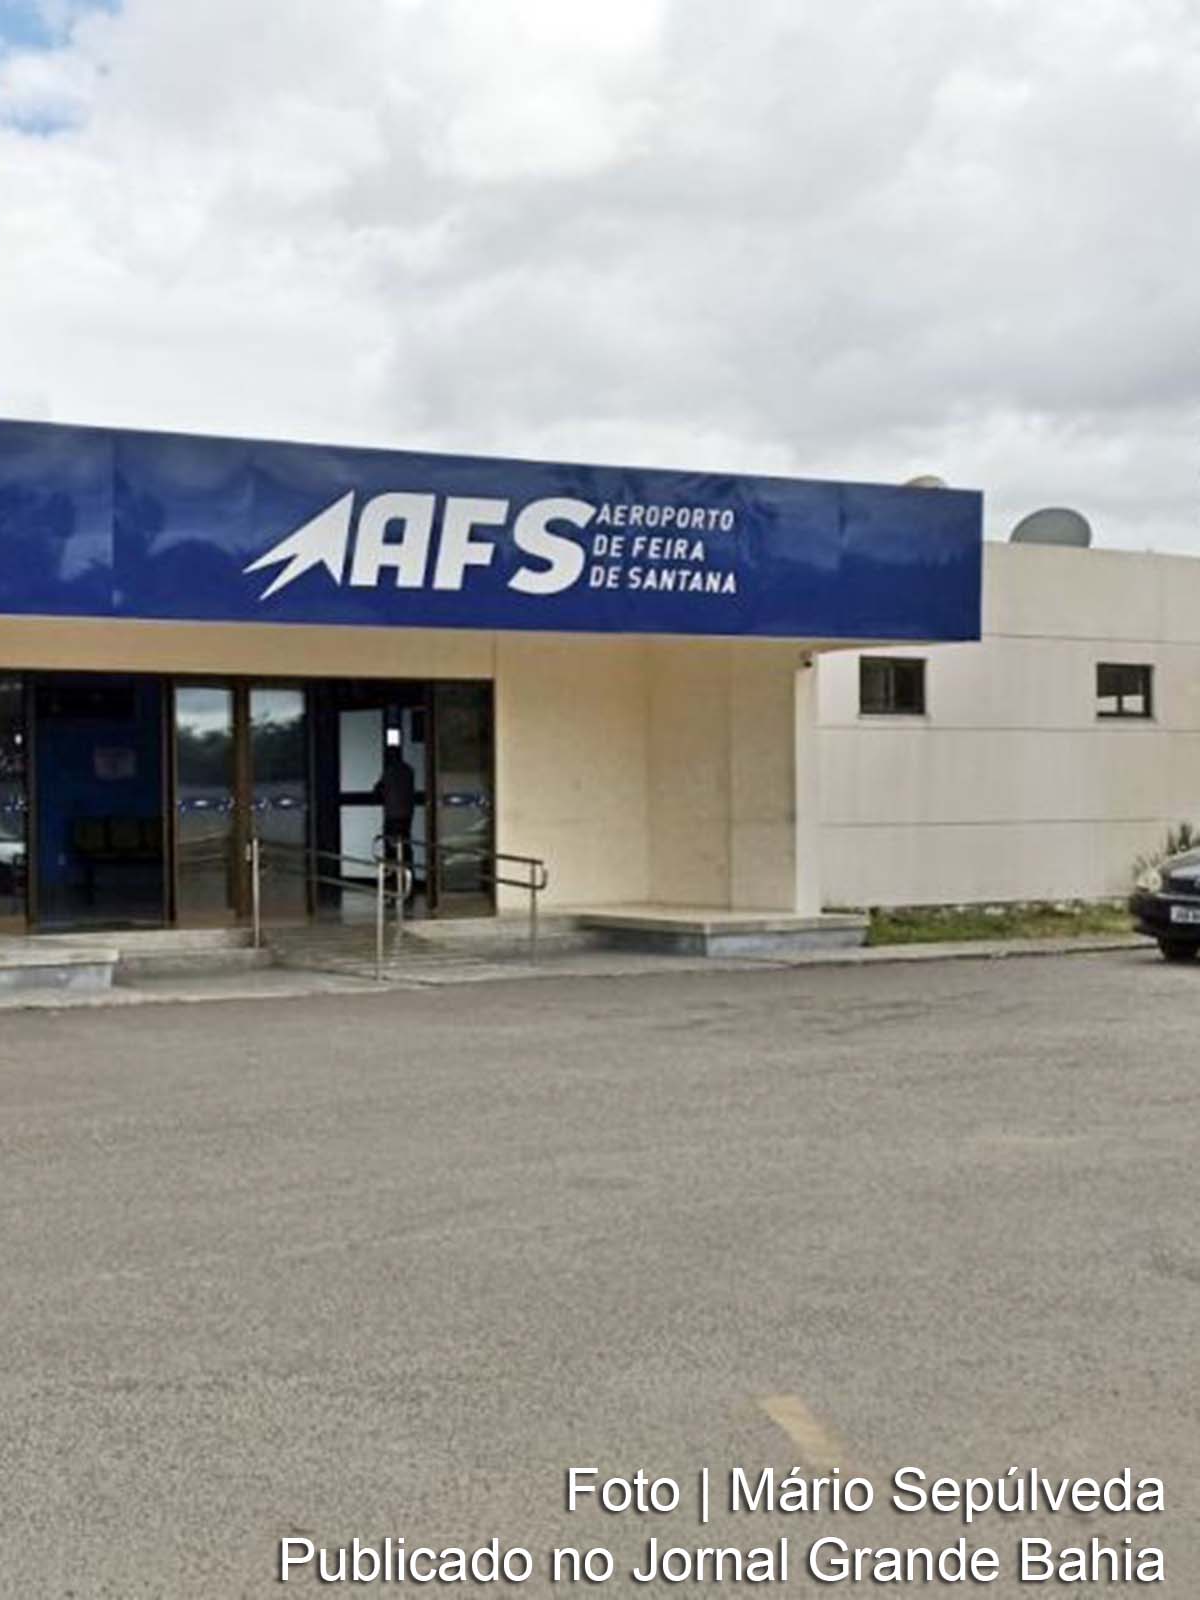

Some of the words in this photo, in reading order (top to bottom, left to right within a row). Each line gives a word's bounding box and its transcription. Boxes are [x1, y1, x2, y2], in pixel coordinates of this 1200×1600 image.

[596, 503, 735, 531] AEROPORTO
[349, 492, 597, 595] AFS
[593, 534, 624, 558] DE
[632, 536, 705, 562] FEIRA
[589, 565, 620, 589] DE
[628, 566, 737, 594] SANTANA
